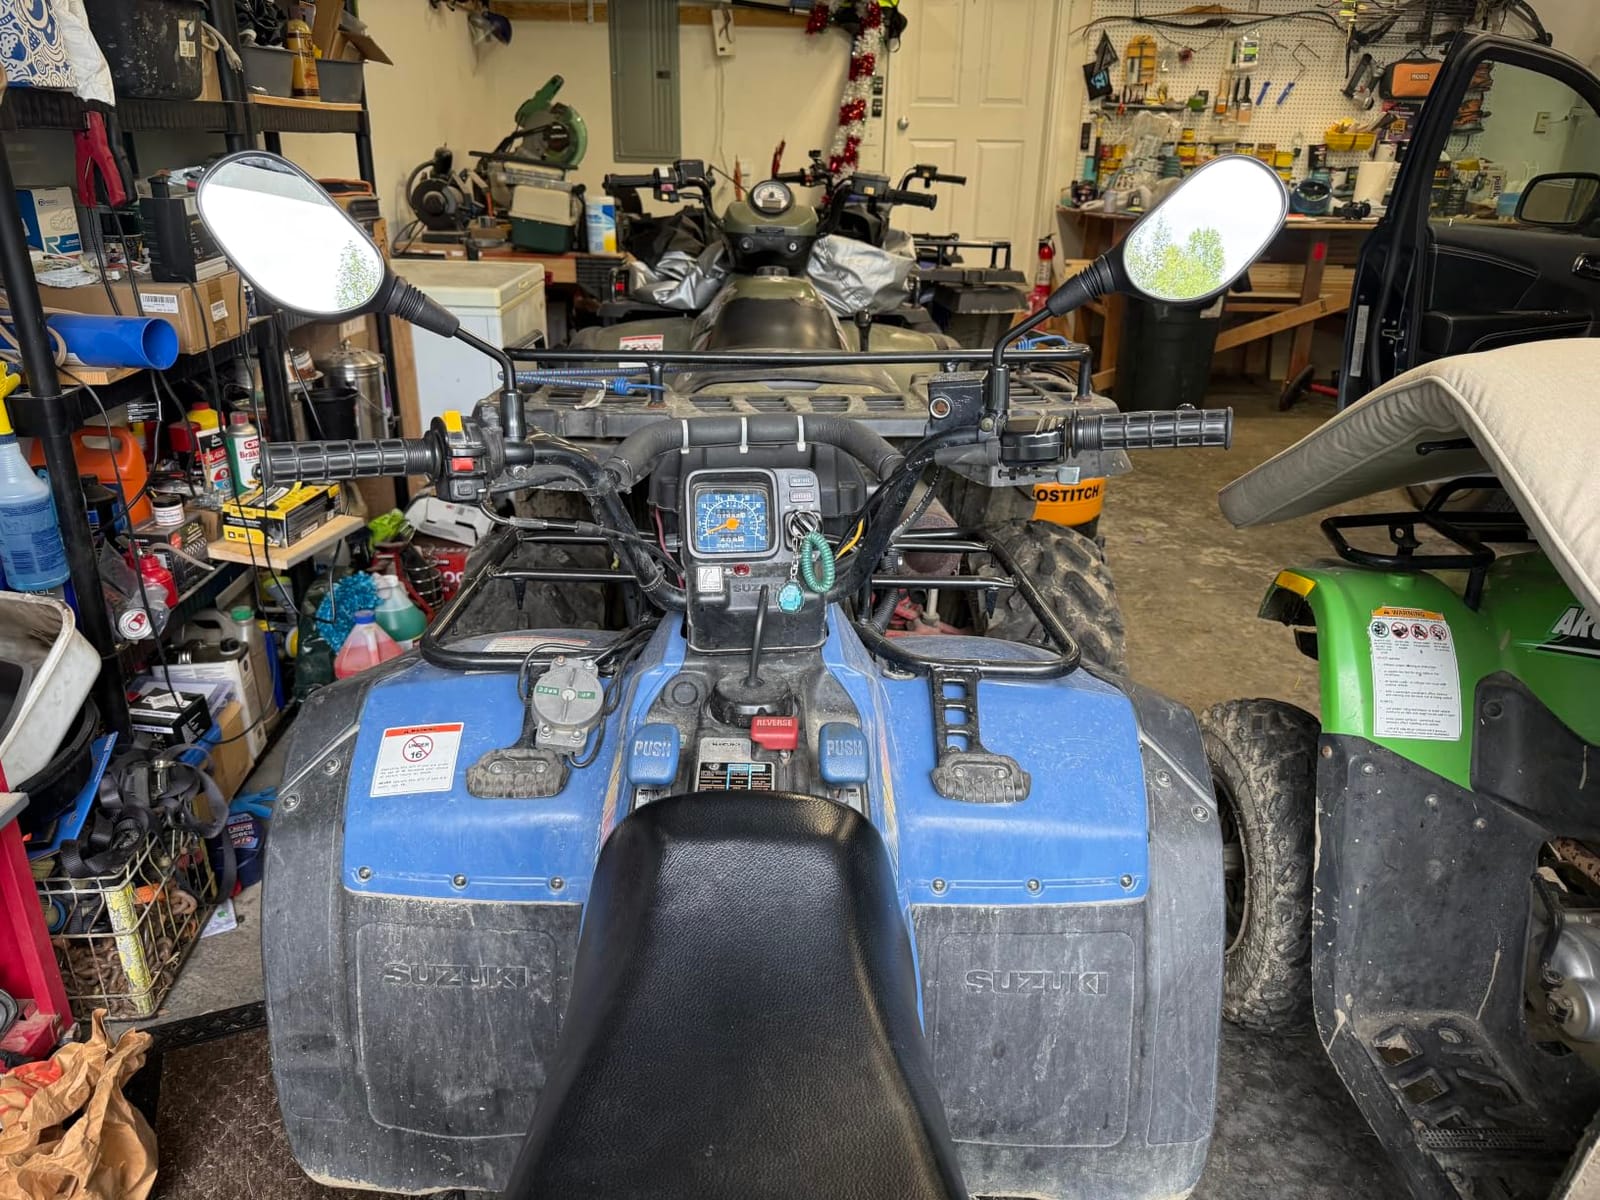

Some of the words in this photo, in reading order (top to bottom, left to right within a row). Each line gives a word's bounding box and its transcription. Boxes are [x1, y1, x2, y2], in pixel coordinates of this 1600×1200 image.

[756, 719, 793, 727] REVERSE
[411, 751, 422, 759] 16
[633, 740, 672, 757] PUSH
[826, 740, 863, 756] PUSH
[384, 962, 528, 988] SUZUKI
[966, 969, 1108, 995] SUZUKI
